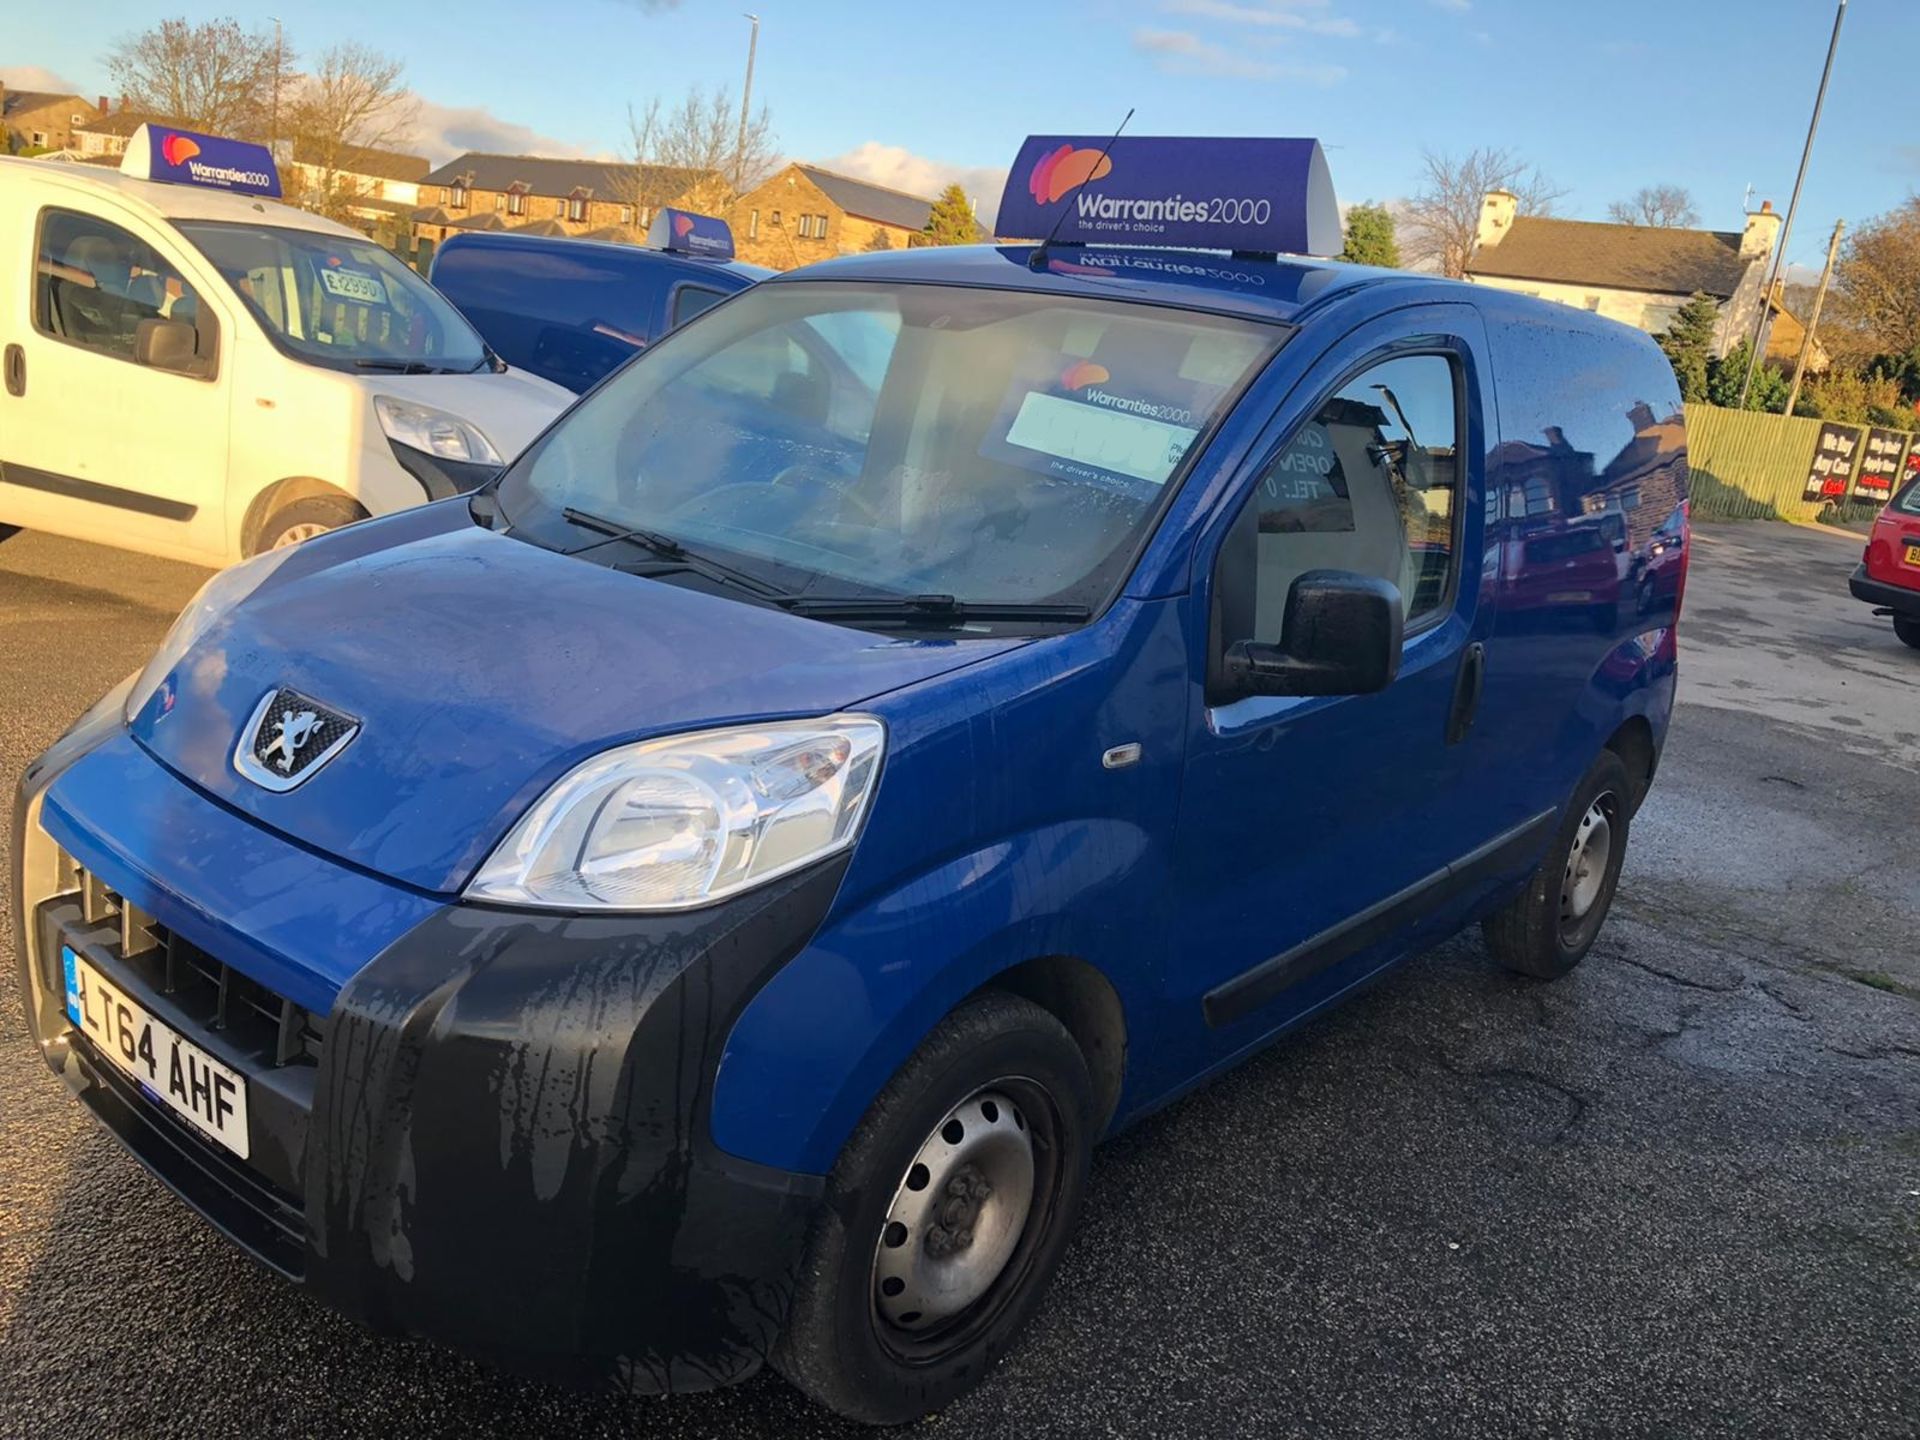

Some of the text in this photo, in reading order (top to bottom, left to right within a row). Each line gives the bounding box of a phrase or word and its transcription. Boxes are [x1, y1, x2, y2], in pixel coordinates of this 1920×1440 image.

[188, 160, 270, 187] Warranties2000
[1078, 192, 1270, 224] Warranties2000
[1079, 220, 1165, 233] the driver's choice
[1086, 388, 1191, 423] Warranties2000
[1823, 433, 1838, 450] We
[1813, 454, 1851, 476] Any Cars
[1807, 475, 1824, 492] For
[80, 970, 236, 1131] LT64 AHF
